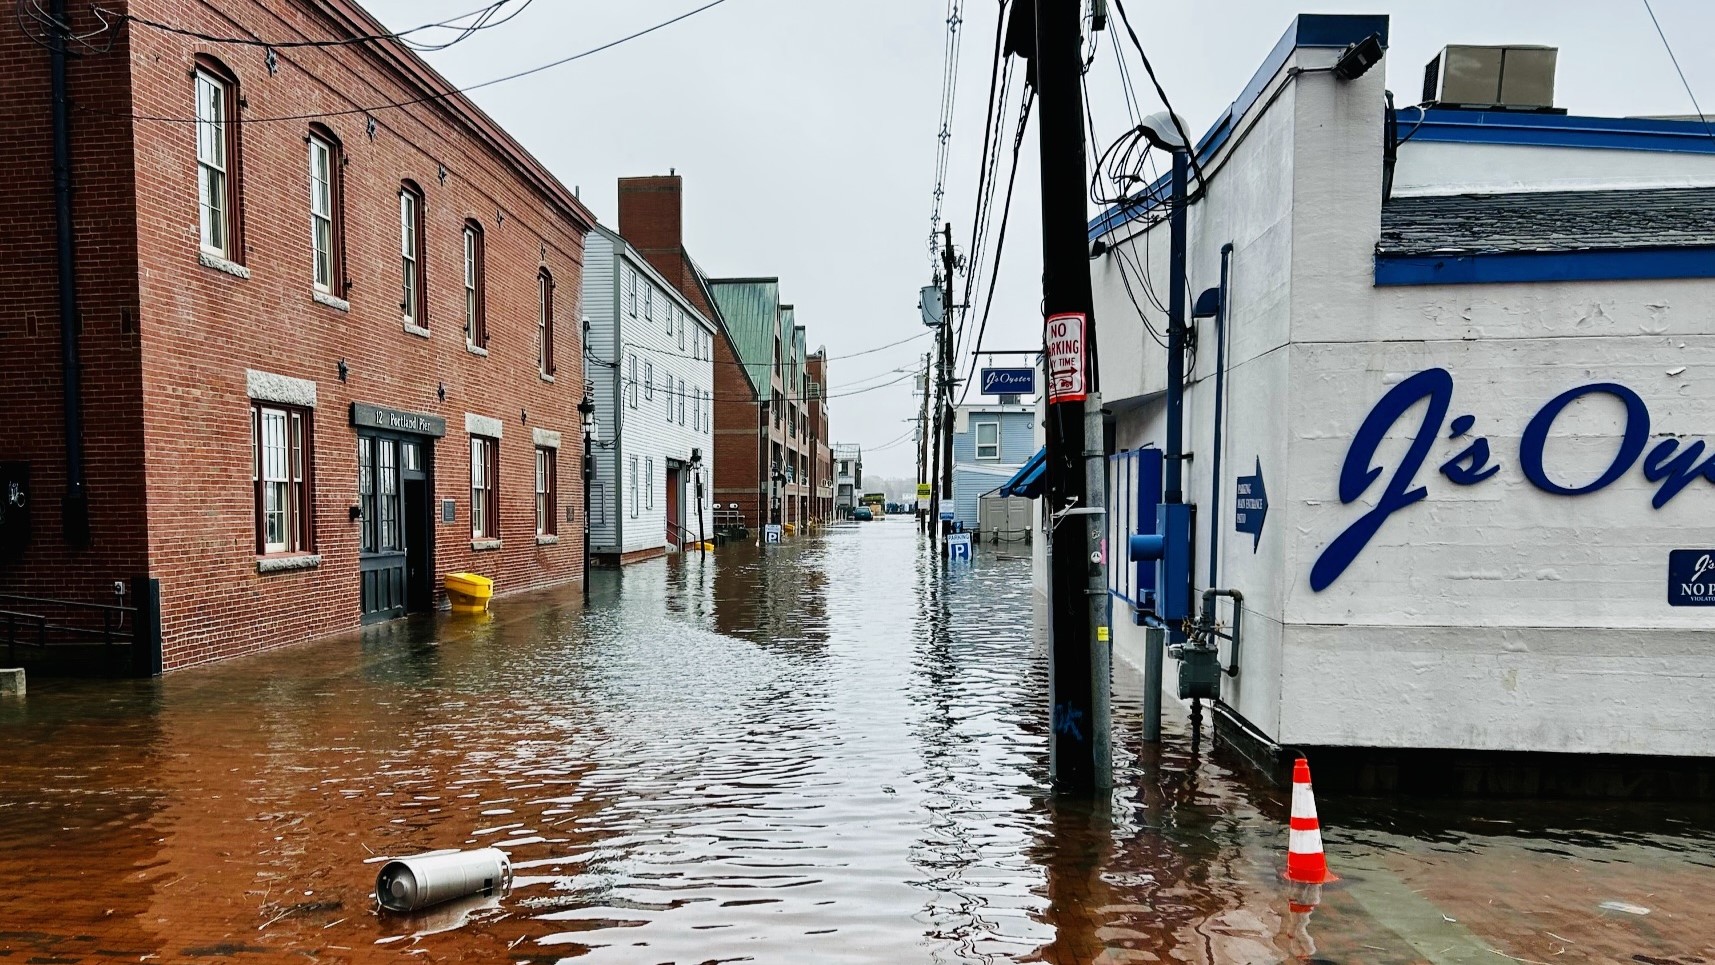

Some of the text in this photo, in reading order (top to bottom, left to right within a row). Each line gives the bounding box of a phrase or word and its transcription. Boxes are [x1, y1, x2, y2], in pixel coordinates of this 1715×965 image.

[1051, 323, 1066, 338] NO
[1059, 358, 1076, 367] TIME
[1000, 373, 1031, 384] Oyster
[376, 410, 431, 431] 12 Portland Pier
[1310, 367, 1501, 593] J's
[769, 532, 777, 542] P
[955, 544, 964, 558] P
[1681, 583, 1705, 596] NO
